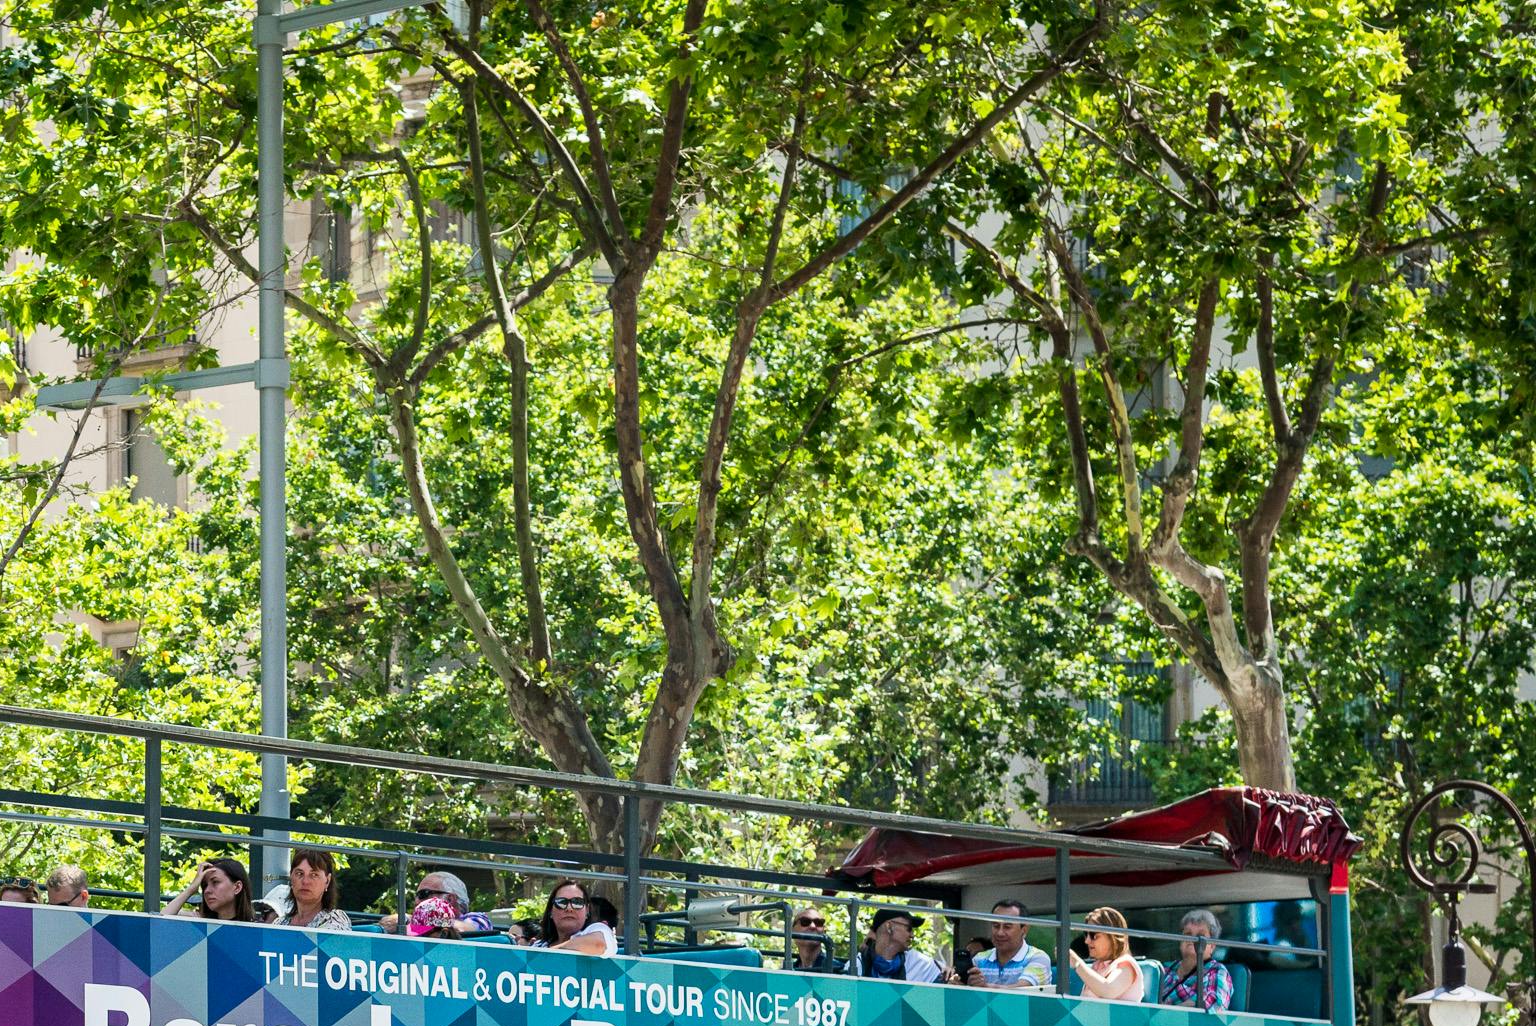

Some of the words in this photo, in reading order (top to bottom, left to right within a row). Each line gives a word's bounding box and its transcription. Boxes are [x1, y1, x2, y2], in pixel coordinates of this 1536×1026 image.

[258, 951, 319, 988] THE
[325, 957, 468, 999] ORIGINAL
[473, 968, 492, 1001] &
[496, 971, 625, 1011] OFFICIAL
[629, 982, 704, 1017] TOUR
[713, 989, 790, 1025] SINCE
